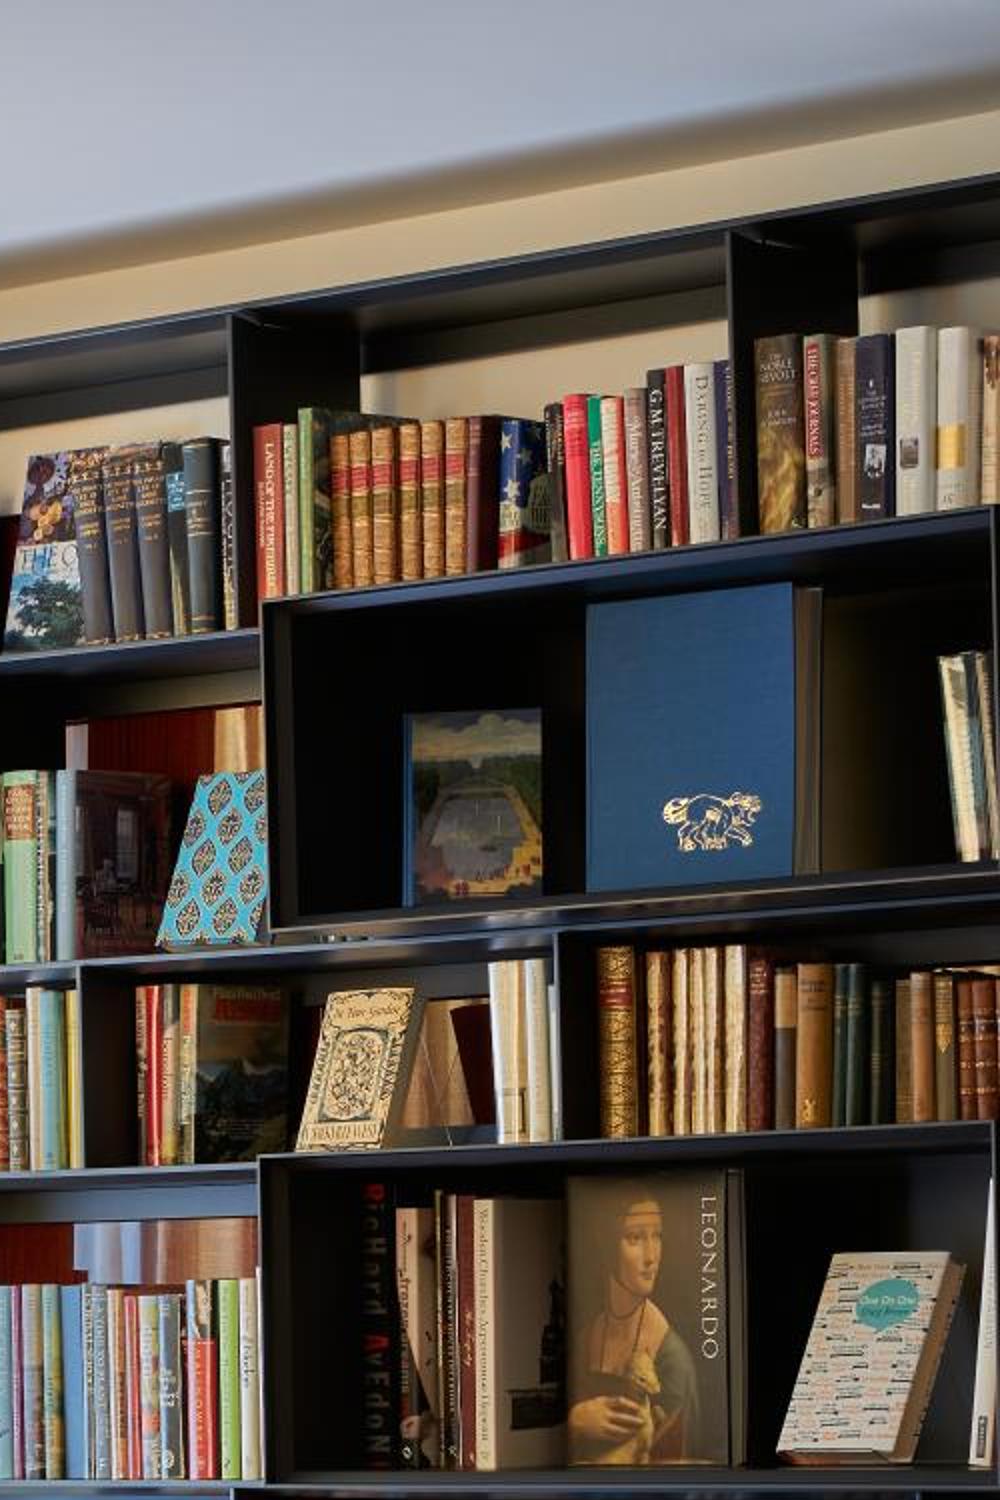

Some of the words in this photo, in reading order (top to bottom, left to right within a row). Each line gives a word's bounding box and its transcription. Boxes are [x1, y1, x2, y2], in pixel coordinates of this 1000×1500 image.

[695, 376, 709, 443] DARING
[651, 426, 667, 529] TREVELYAN
[698, 467, 712, 508] HOPE
[700, 1196, 719, 1360] LEONARDO
